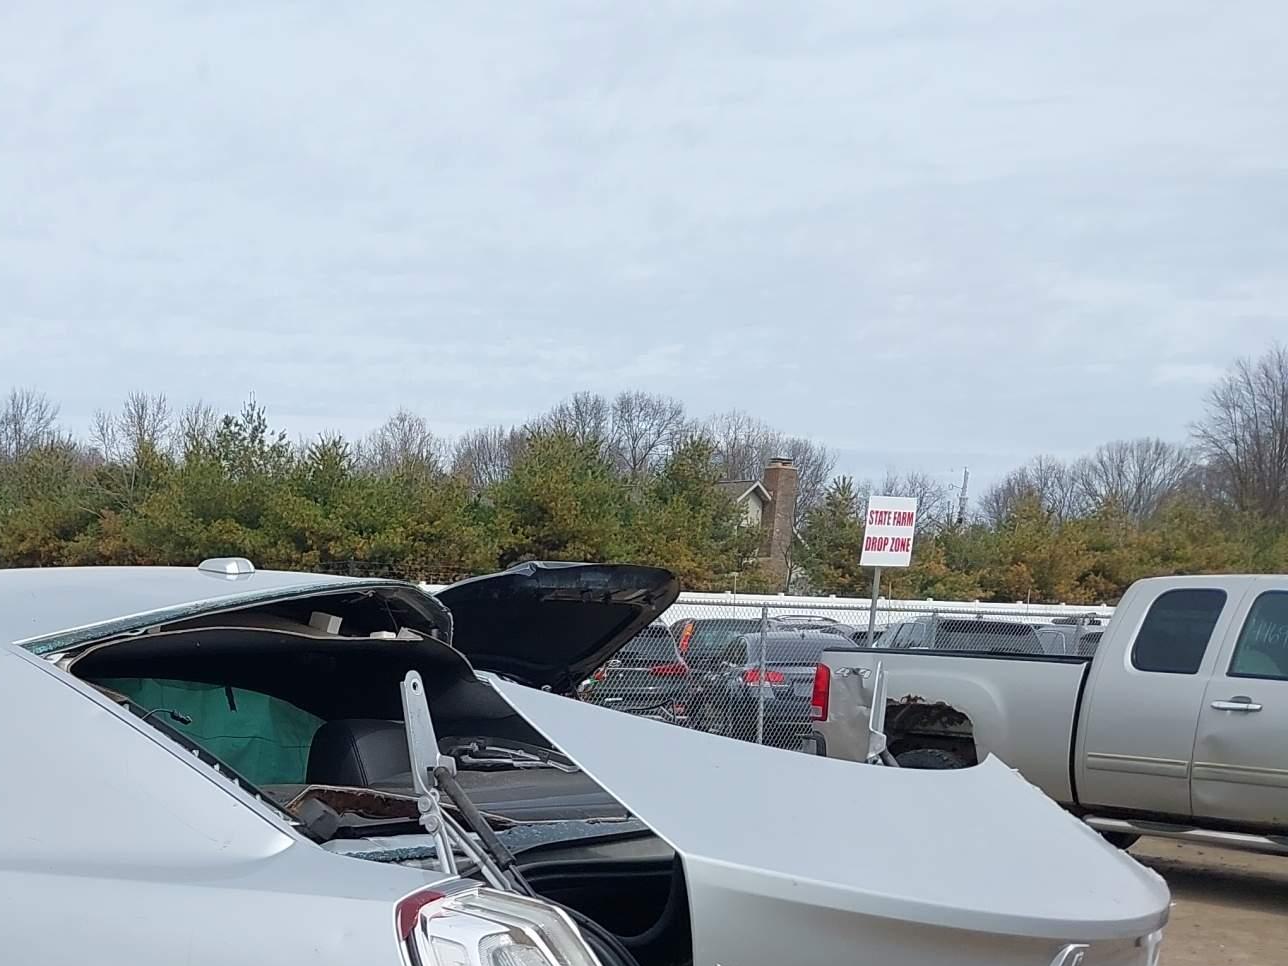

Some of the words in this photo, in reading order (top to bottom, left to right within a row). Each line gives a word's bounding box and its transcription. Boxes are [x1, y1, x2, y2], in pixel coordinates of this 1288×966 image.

[868, 510, 893, 526] STATE
[893, 511, 915, 527] FARM
[864, 536, 889, 552] DROP
[889, 537, 912, 553] ZONE
